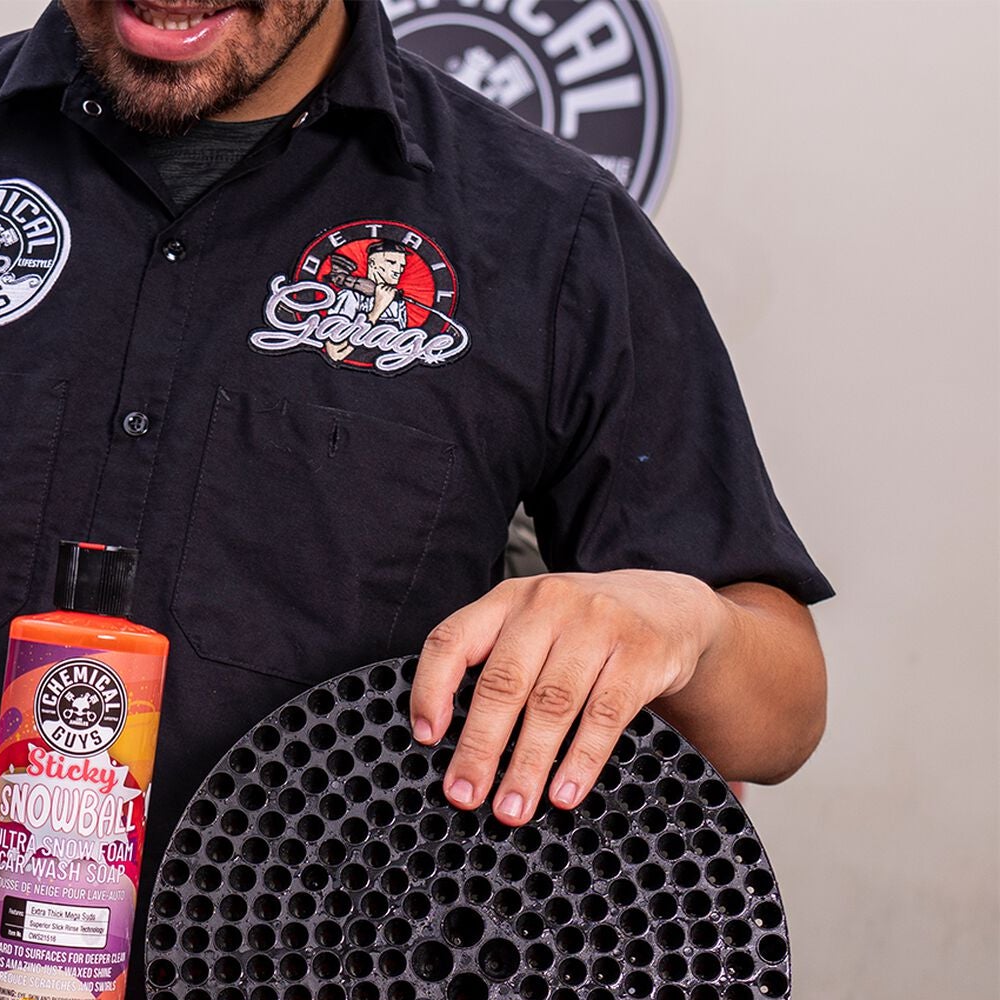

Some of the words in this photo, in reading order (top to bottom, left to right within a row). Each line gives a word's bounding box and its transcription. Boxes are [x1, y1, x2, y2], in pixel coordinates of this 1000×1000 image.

[302, 224, 455, 303] DETAIL
[250, 275, 462, 372] Garage
[42, 666, 120, 713] CHEMICAL
[51, 725, 102, 749] GUYS
[27, 746, 119, 793] Sticky
[0, 783, 136, 838] SNOWBALL
[41, 836, 94, 860] SNOW
[100, 842, 134, 861] FOAM
[32, 857, 80, 881] WASH
[87, 863, 126, 883] SOAP
[21, 882, 31, 893] DE
[33, 884, 59, 897] NEIGE
[62, 888, 85, 899] POUR
[47, 908, 63, 918] Thick
[14, 945, 24, 958] TO
[25, 947, 67, 963] SURFACES
[68, 952, 84, 964] FOR
[84, 952, 111, 964] DEEPER
[4, 958, 42, 973] AMAZING
[93, 967, 112, 978] SHINE
